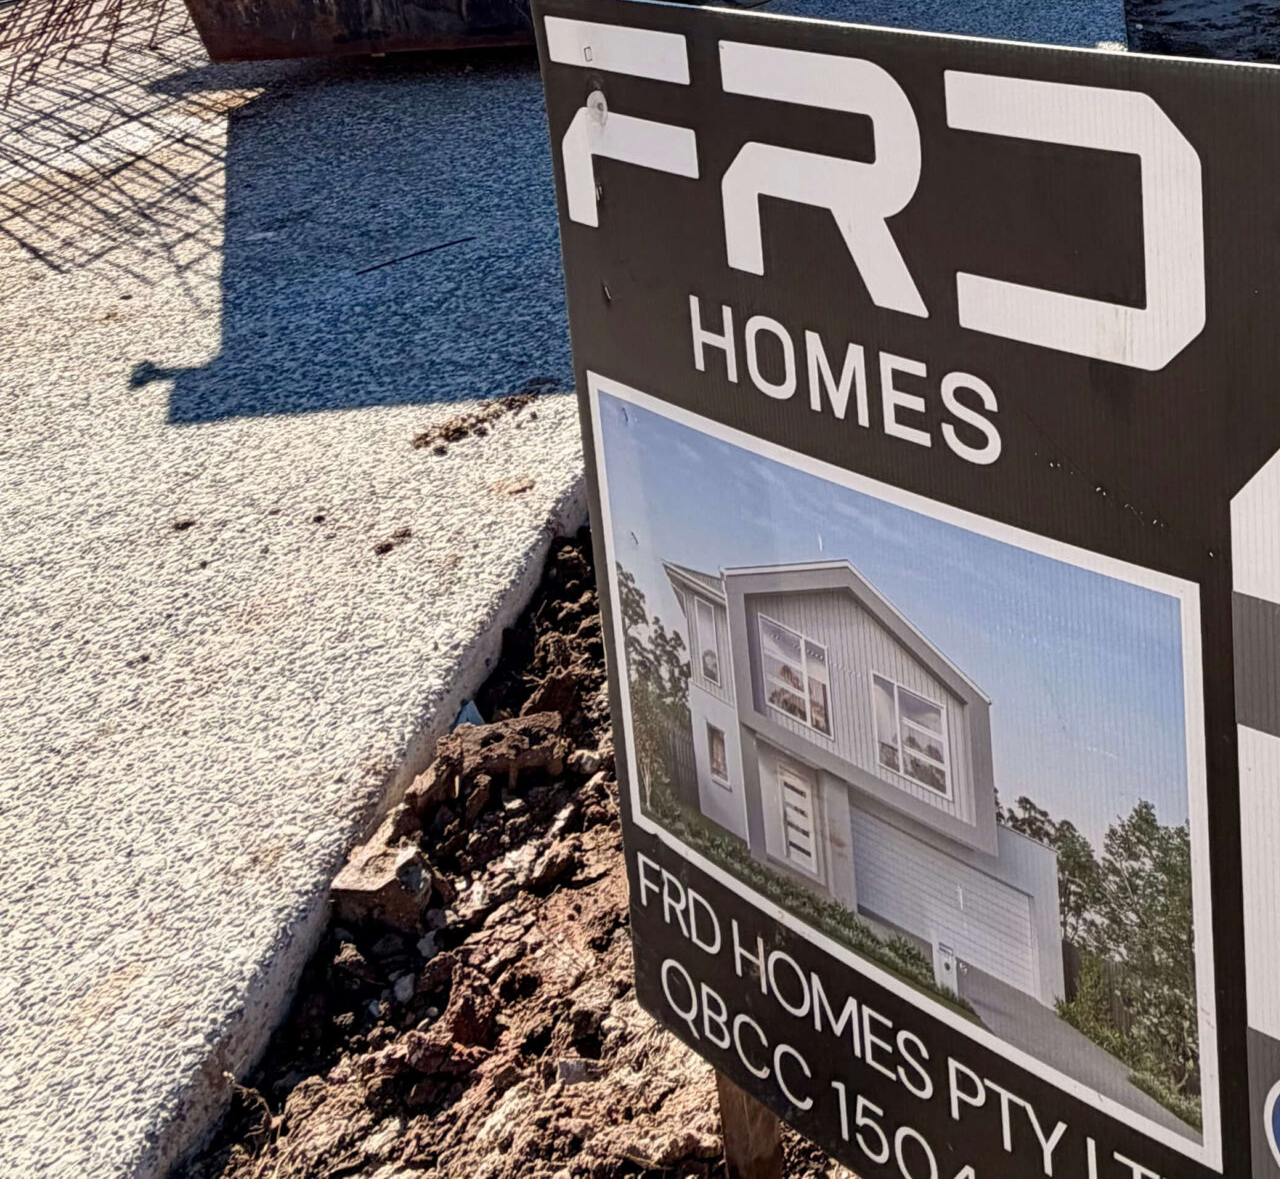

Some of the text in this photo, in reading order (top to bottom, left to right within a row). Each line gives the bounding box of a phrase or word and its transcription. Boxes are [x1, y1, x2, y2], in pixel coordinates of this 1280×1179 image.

[543, 14, 1206, 371] FRD
[688, 294, 1002, 466] HOMES
[636, 851, 721, 956] FRD
[732, 919, 933, 1100] HOMES
[947, 1056, 1068, 1177] PTY
[660, 958, 976, 1179] QBCC 150
